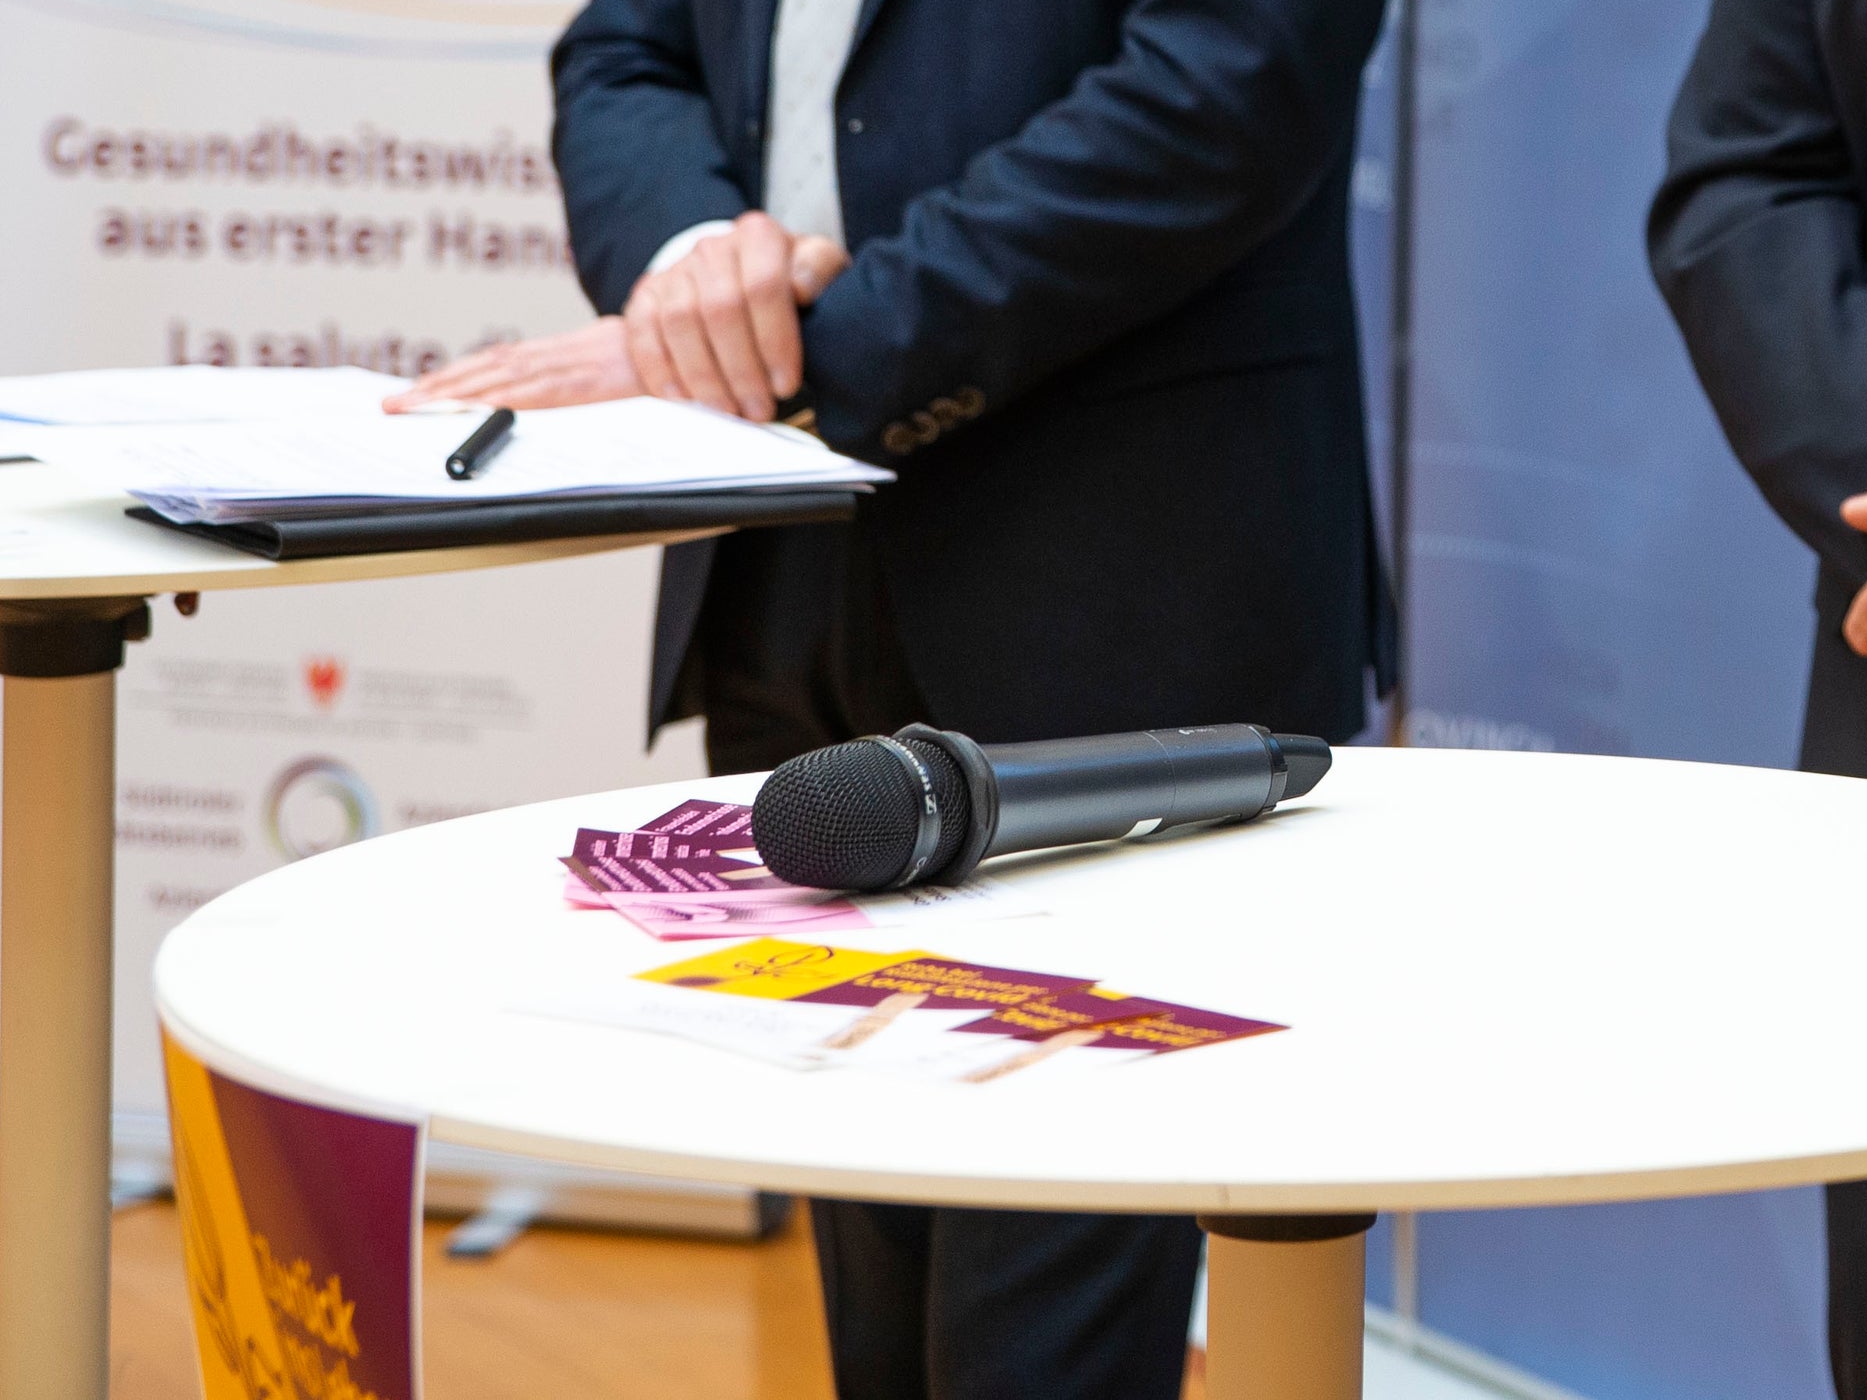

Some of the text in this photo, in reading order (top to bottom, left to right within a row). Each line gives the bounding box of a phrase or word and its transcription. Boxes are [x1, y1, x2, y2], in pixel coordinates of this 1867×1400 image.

[43, 116, 556, 192] Gesundheitswis
[97, 208, 206, 256] aus
[221, 211, 411, 264] erster
